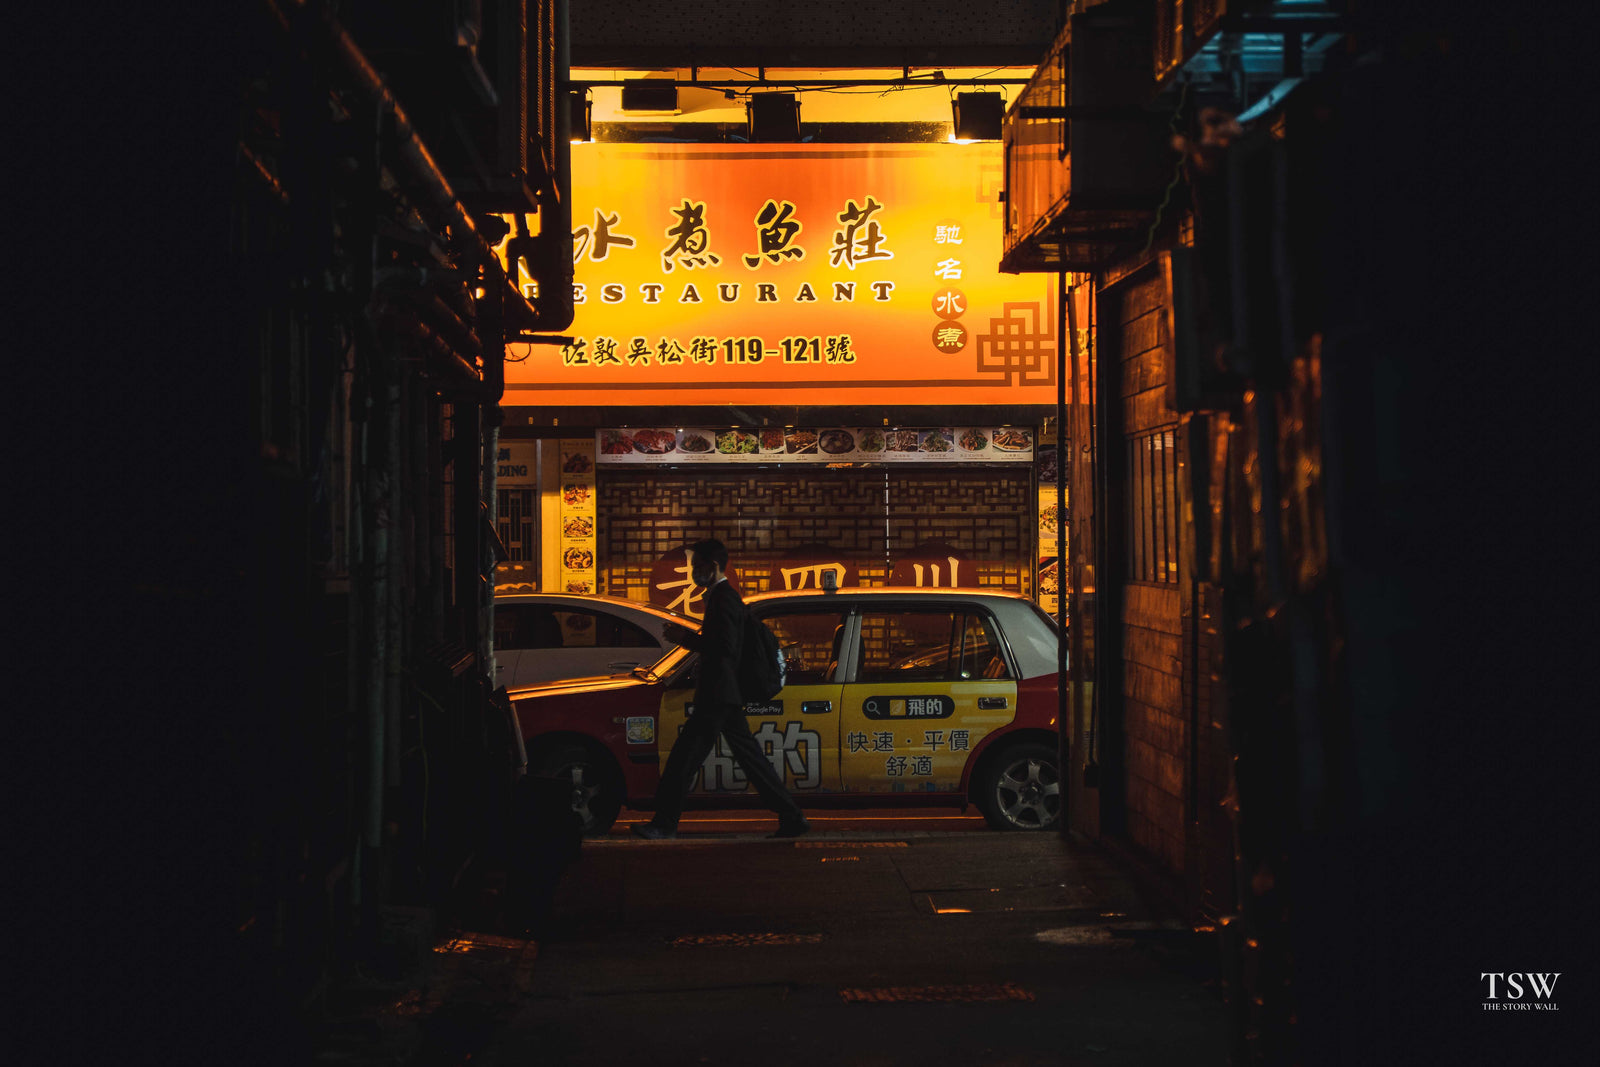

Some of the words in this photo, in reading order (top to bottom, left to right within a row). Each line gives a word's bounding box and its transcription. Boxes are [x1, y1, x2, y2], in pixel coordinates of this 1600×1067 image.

[934, 225, 964, 347] 馳名水煮
[498, 465, 527, 477] DING
[746, 706, 768, 714] Google
[908, 698, 943, 716] 飛的
[886, 755, 933, 777] 舒適
